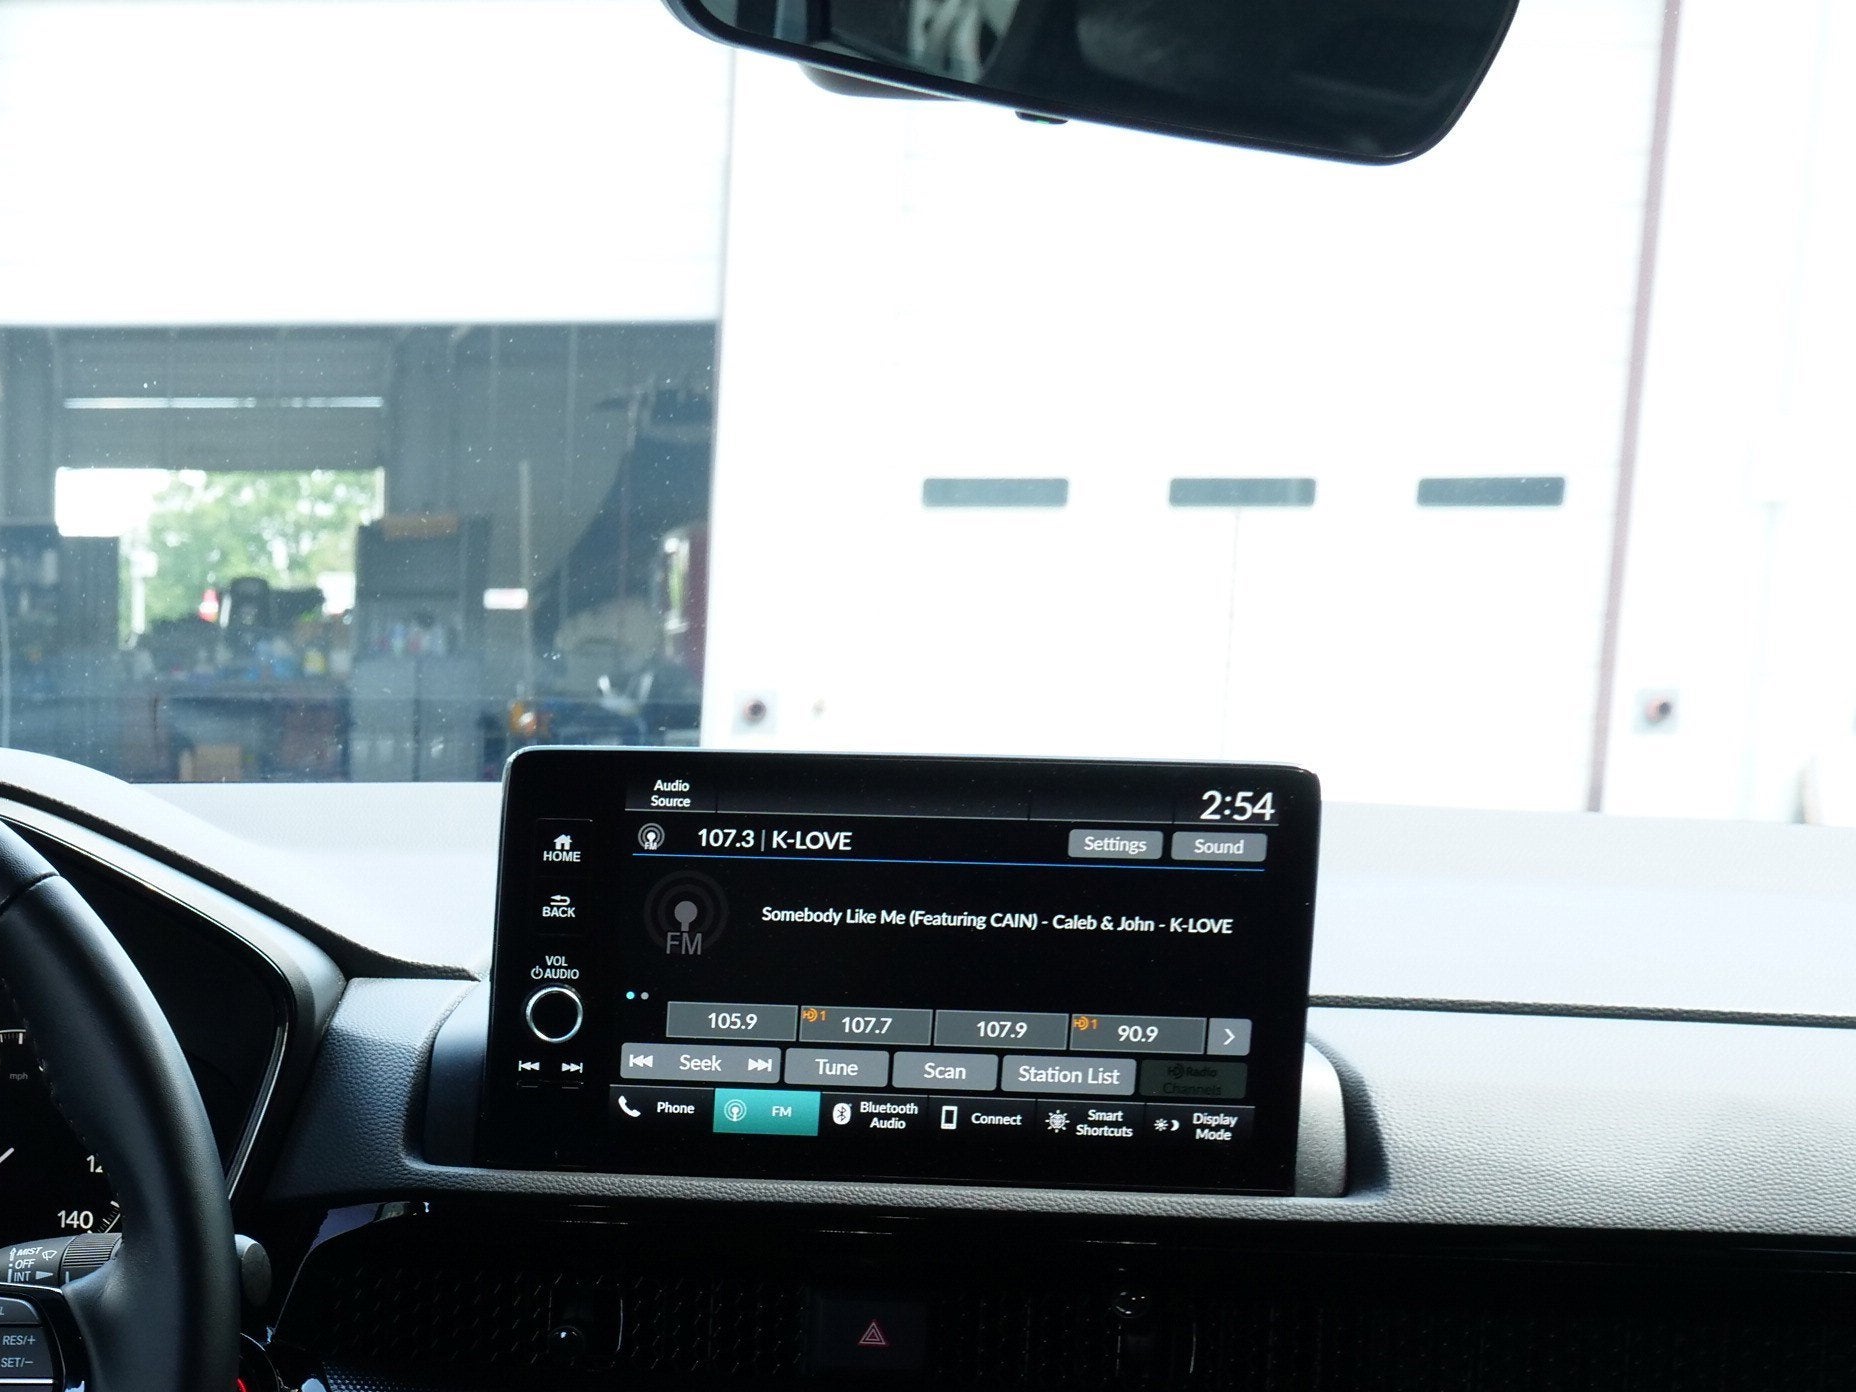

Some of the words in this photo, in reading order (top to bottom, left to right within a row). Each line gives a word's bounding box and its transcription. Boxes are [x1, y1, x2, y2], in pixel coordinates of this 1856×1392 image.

[653, 779, 690, 793] Audio
[650, 795, 691, 808] Source
[1200, 790, 1276, 822] 2:54
[698, 828, 754, 848] 107.3
[772, 830, 853, 851] K-LOVE
[1084, 836, 1147, 855] Settings
[1194, 838, 1244, 855] Sound
[543, 851, 581, 863] HOME
[542, 906, 576, 919] BACK
[761, 906, 842, 926] Somebody
[846, 908, 876, 924] Like
[880, 909, 906, 925] Me
[909, 909, 986, 930] (Featuring
[990, 911, 1038, 930] CAIN)
[1053, 914, 1097, 930] Caleb
[1100, 916, 1114, 931] &
[1117, 917, 1154, 932] John
[1169, 918, 1234, 934] K-LOVE
[666, 932, 702, 956] FM
[545, 955, 568, 967] VOL
[544, 968, 580, 980] AUDIO
[708, 1012, 758, 1030] 105.9
[842, 1017, 892, 1035] 107.7
[976, 1021, 1028, 1039] 107.9
[1118, 1025, 1159, 1042] 90.9
[679, 1054, 722, 1072] Seek
[815, 1058, 859, 1076] Tune
[9, 1073, 28, 1081] mph
[923, 1062, 966, 1080] Scan
[1018, 1065, 1082, 1084] Station
[1088, 1067, 1120, 1085] List
[1186, 1066, 1217, 1077] Radio
[656, 1101, 695, 1115] Phone
[771, 1106, 792, 1118] FM
[860, 1101, 918, 1116] Bluetooth
[869, 1116, 906, 1130] Audio
[971, 1112, 1022, 1126] Connect
[1087, 1109, 1123, 1123] Smart
[1192, 1112, 1238, 1128] Display
[1075, 1123, 1133, 1138] Shortcuts
[1195, 1127, 1232, 1141] Mode
[57, 1210, 94, 1229] 140
[16, 1246, 43, 1256] MIST
[14, 1259, 35, 1269] OFF
[13, 1271, 31, 1282] INT
